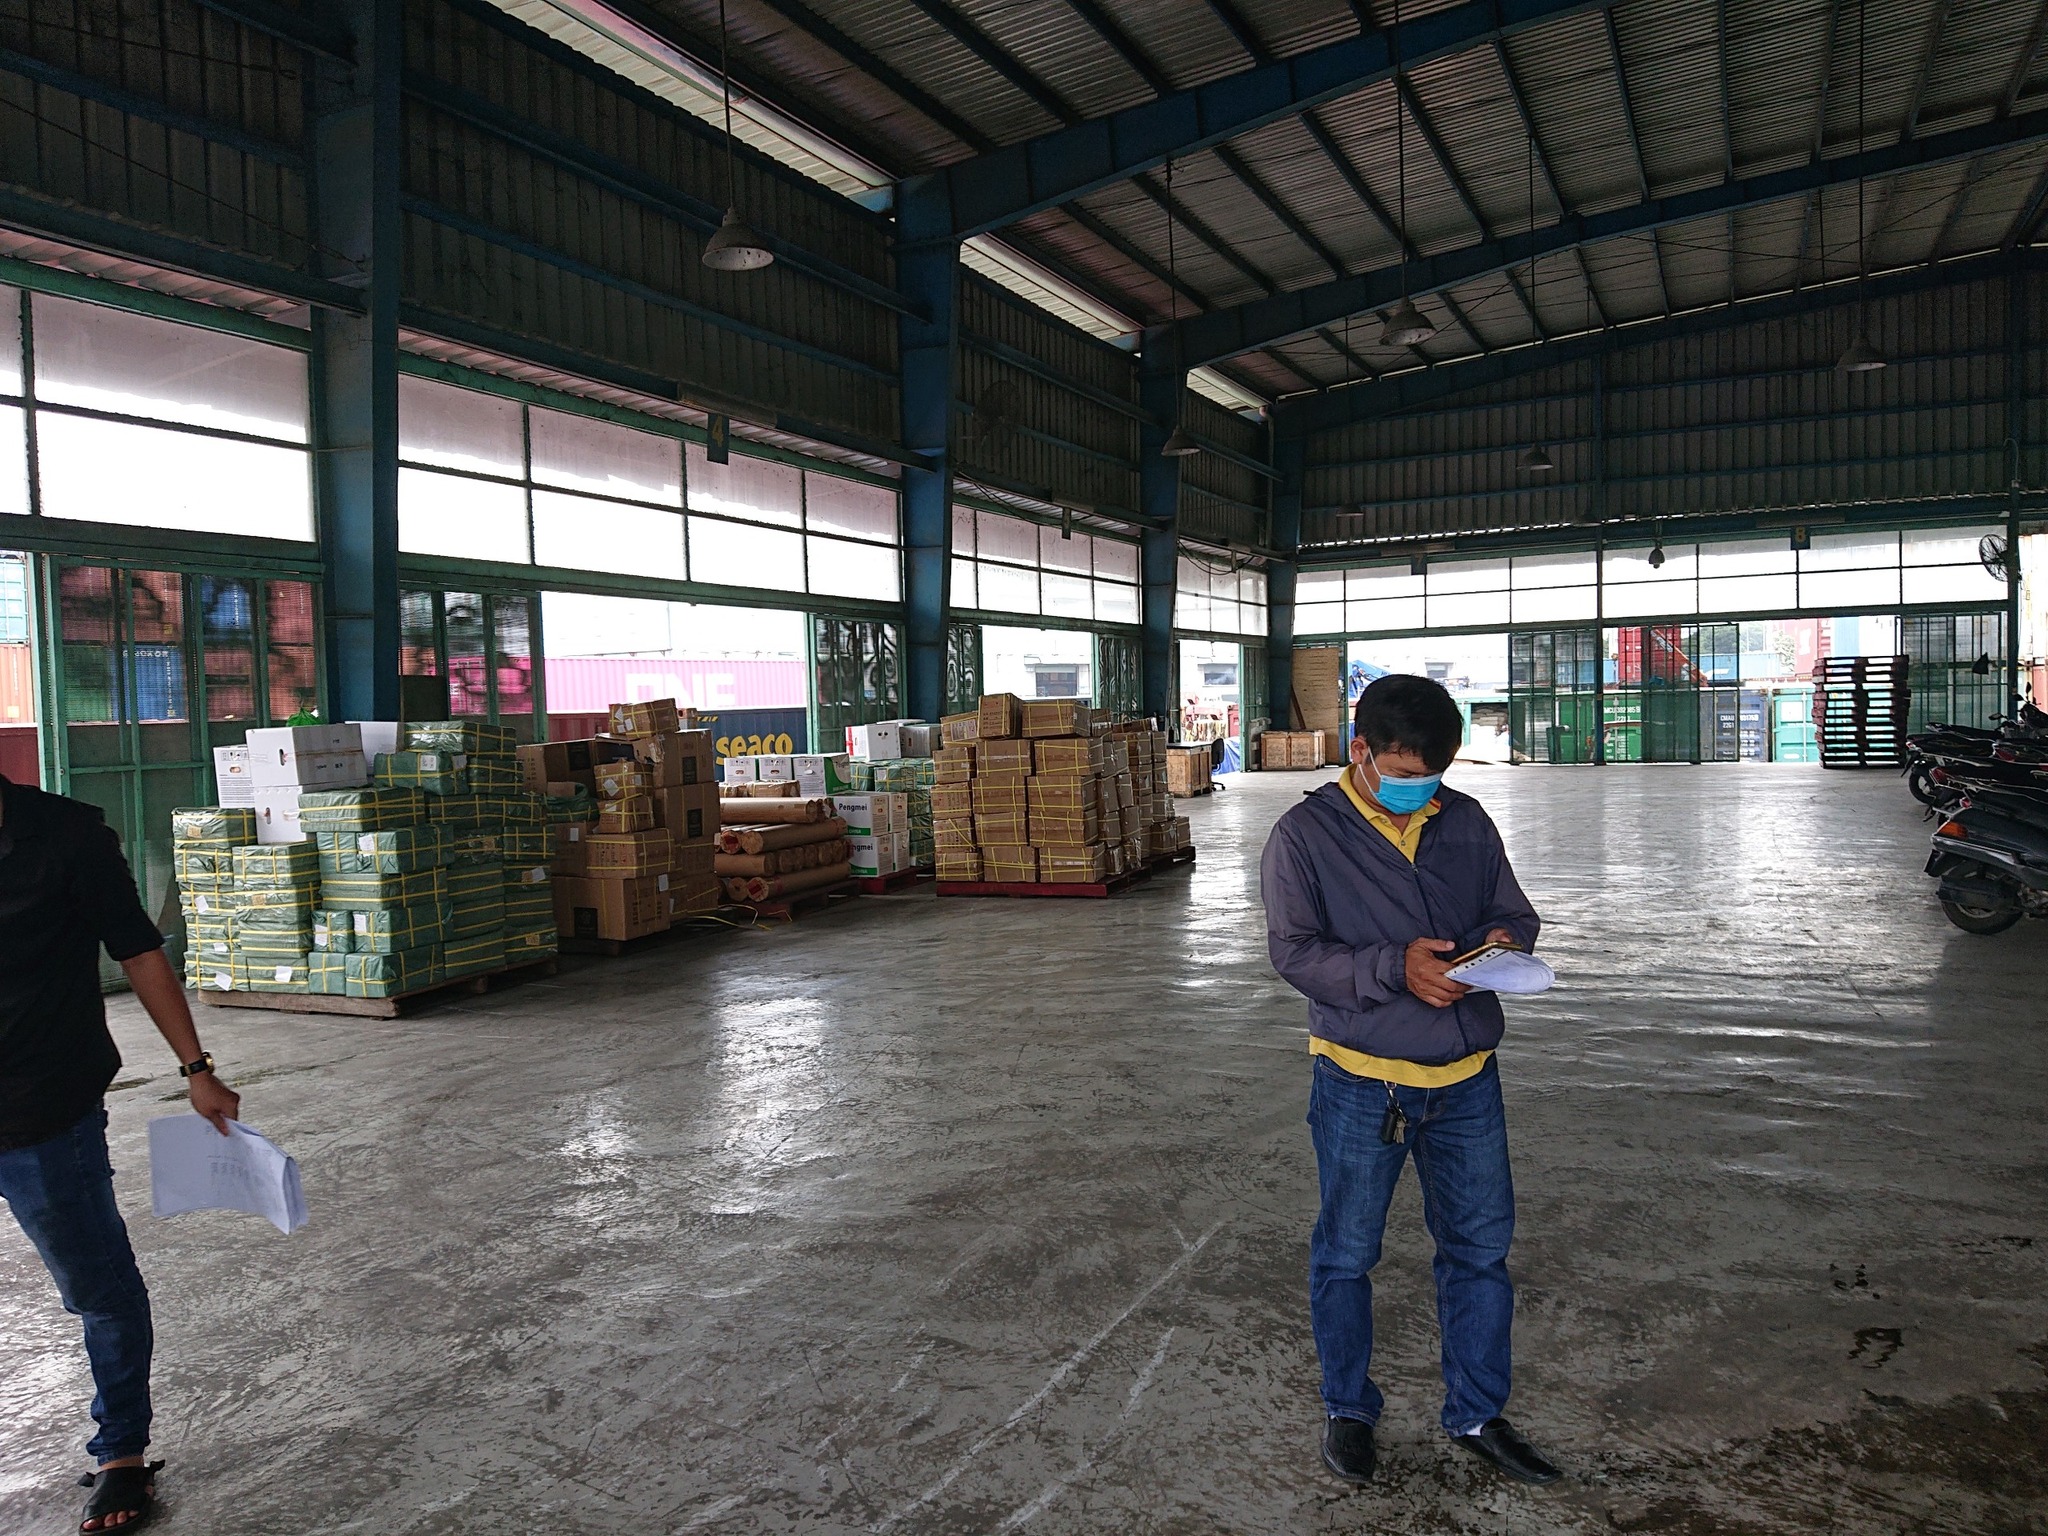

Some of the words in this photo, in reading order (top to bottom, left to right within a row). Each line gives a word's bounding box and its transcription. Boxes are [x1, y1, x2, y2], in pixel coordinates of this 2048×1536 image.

[715, 732, 793, 766] seaco
[838, 803, 868, 812] Pengmei
[852, 843, 874, 852] ngmei
